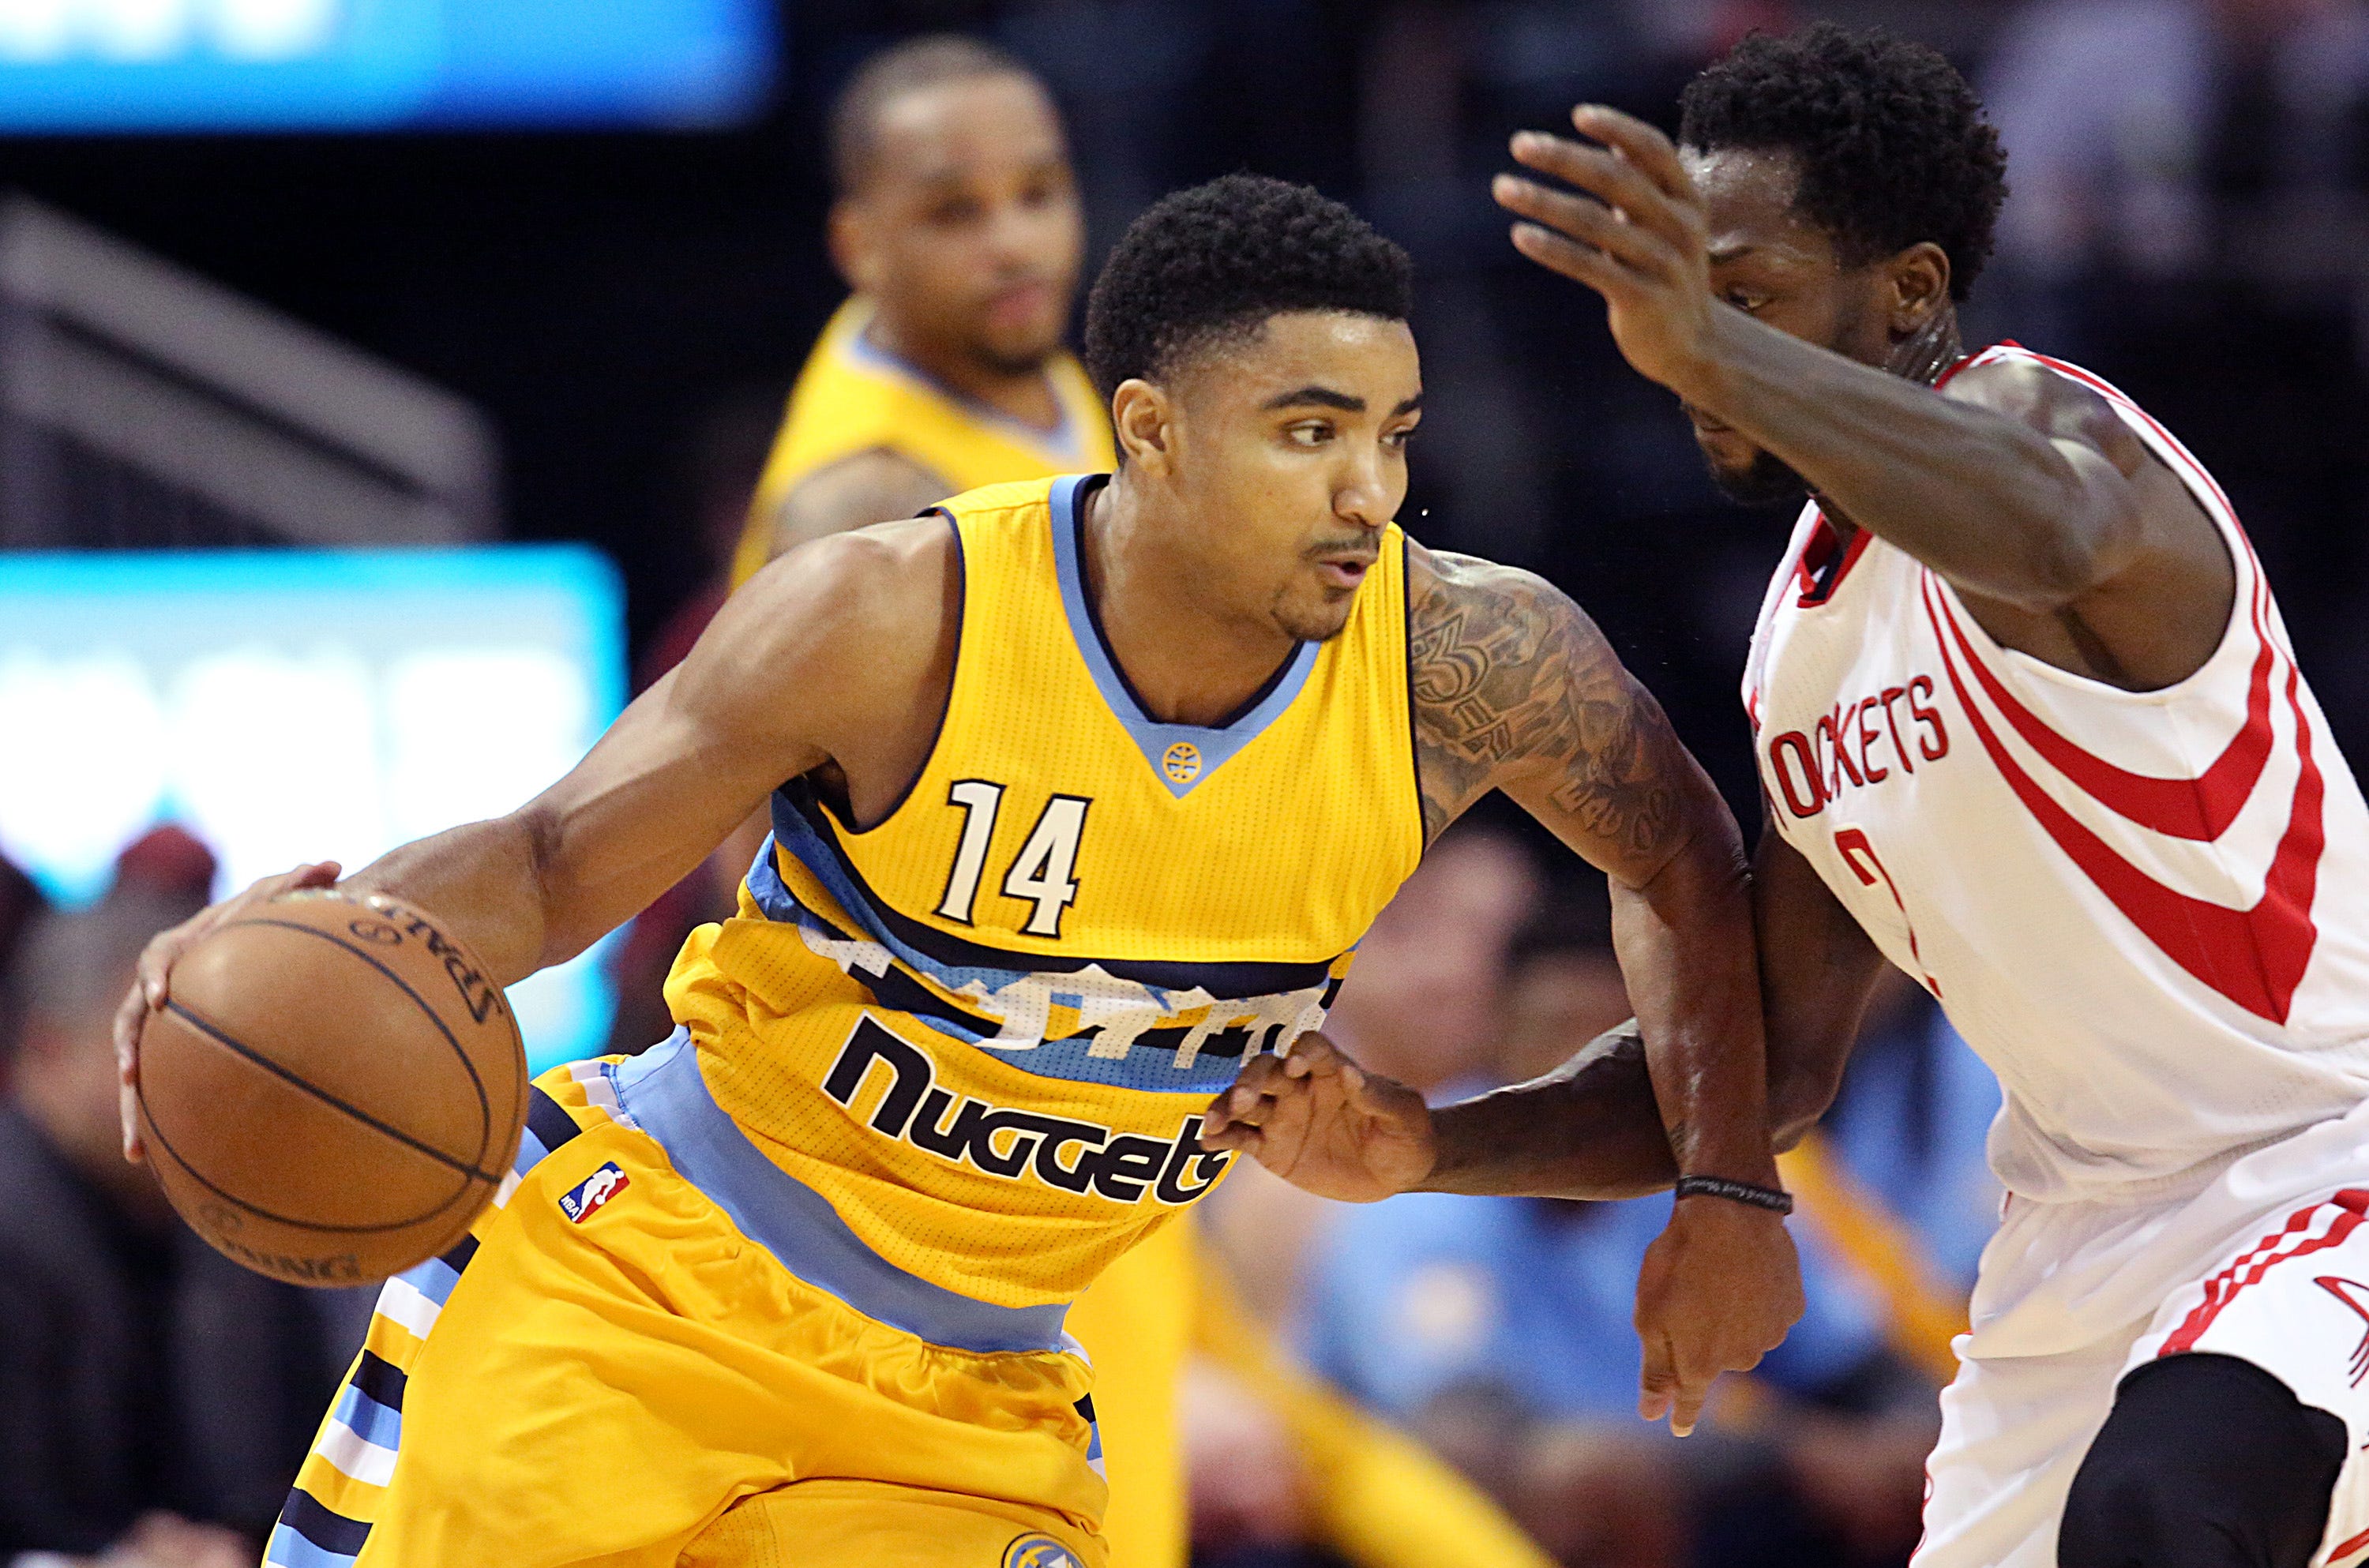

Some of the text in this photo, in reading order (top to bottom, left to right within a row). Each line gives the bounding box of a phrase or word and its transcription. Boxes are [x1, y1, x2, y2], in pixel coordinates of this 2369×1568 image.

[1763, 674, 1949, 829] OCKETS
[932, 778, 1094, 940] 14
[560, 1195, 580, 1217] NBA
